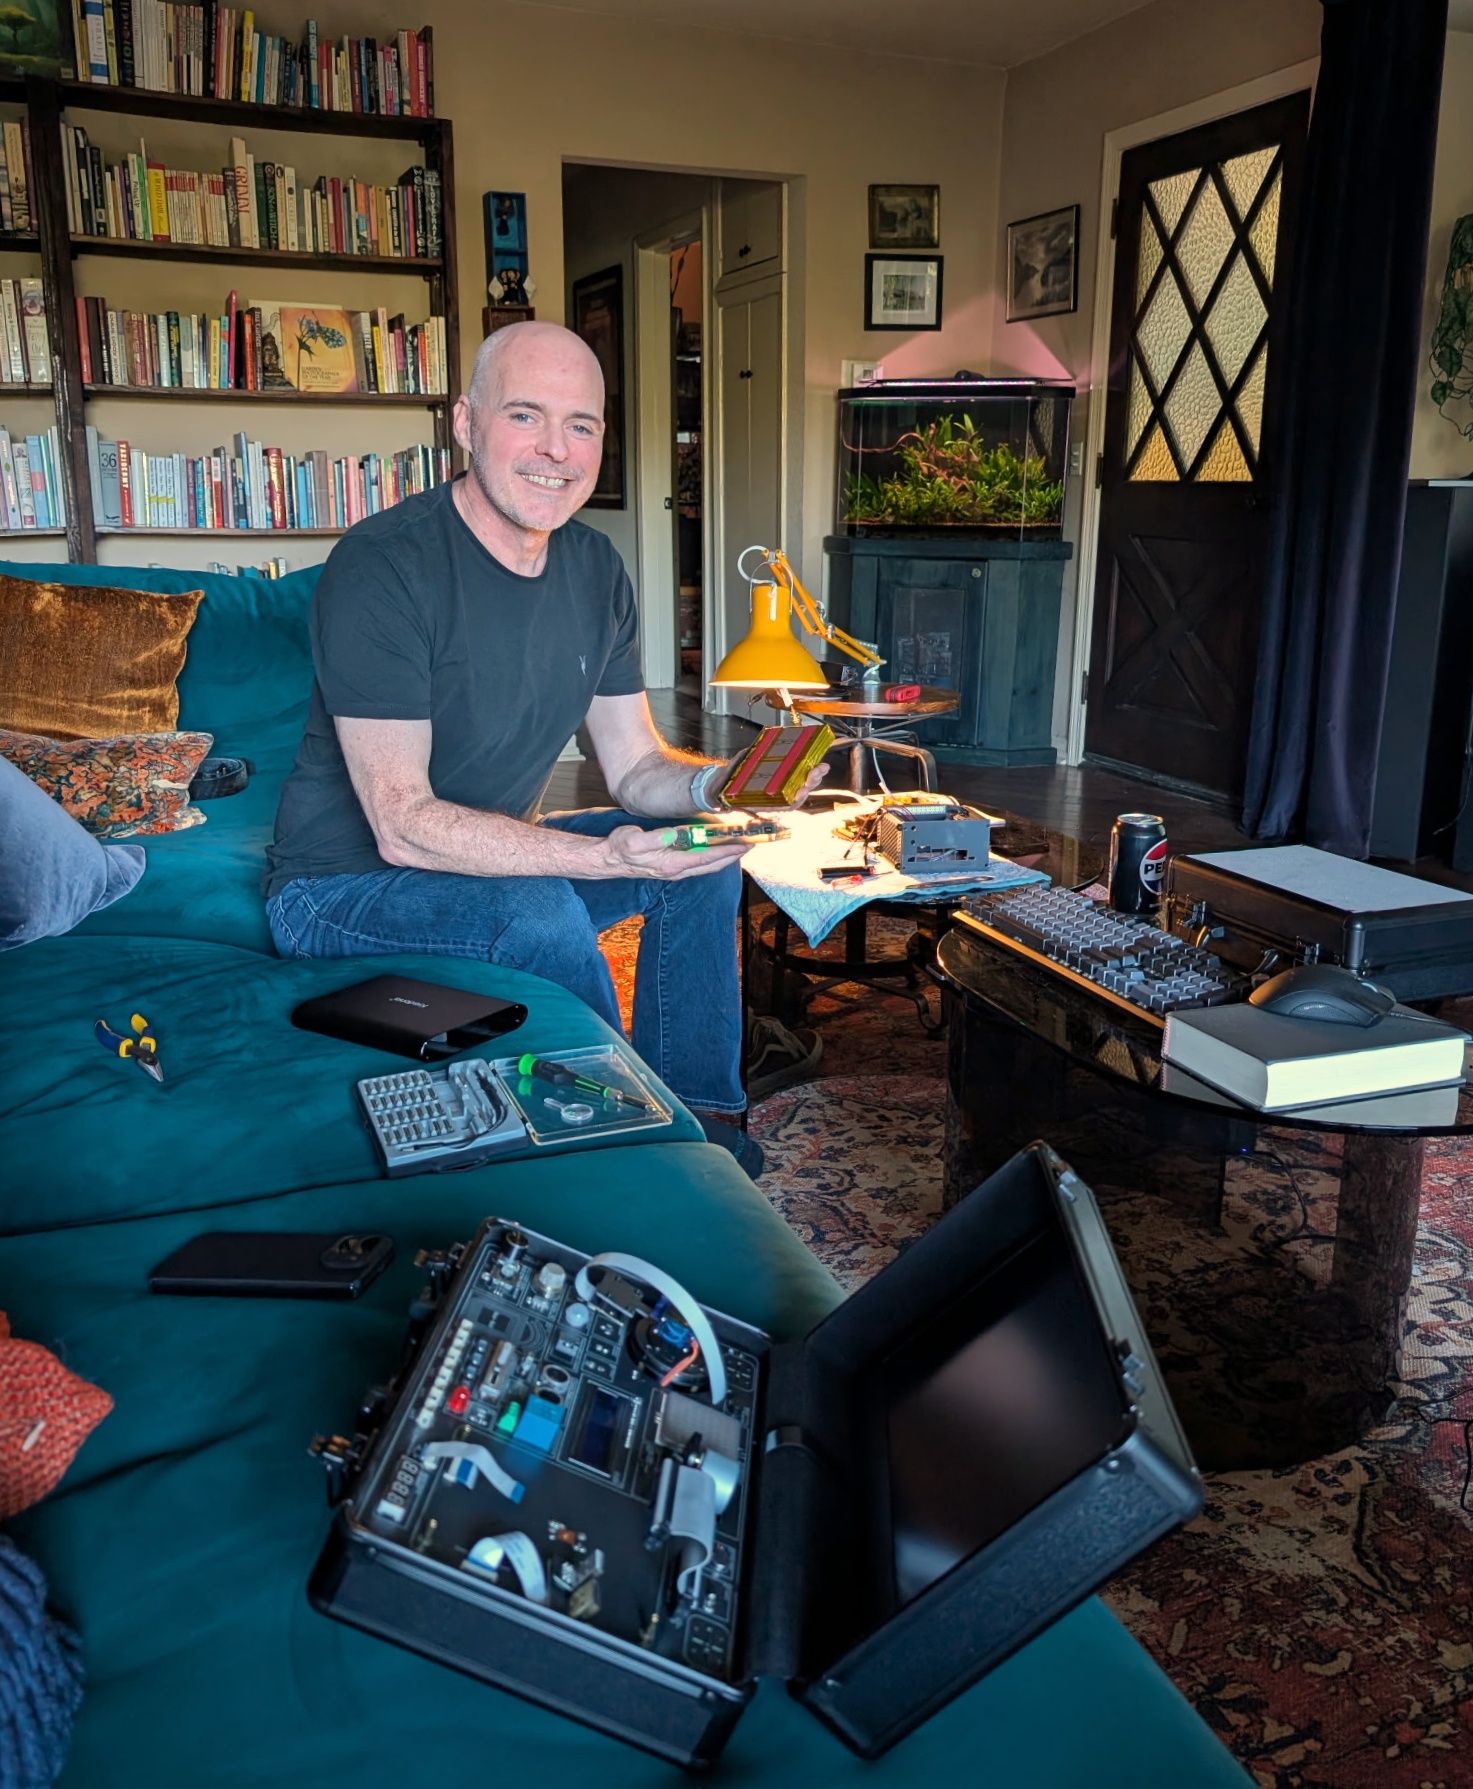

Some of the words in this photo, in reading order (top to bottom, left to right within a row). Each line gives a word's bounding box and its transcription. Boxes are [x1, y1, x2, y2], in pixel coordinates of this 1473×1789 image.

[235, 166, 250, 214] GRIMM
[133, 200, 140, 208] Up
[268, 212, 277, 238] WITCH
[101, 452, 117, 468] 36
[120, 444, 128, 488] TAXIDERMY
